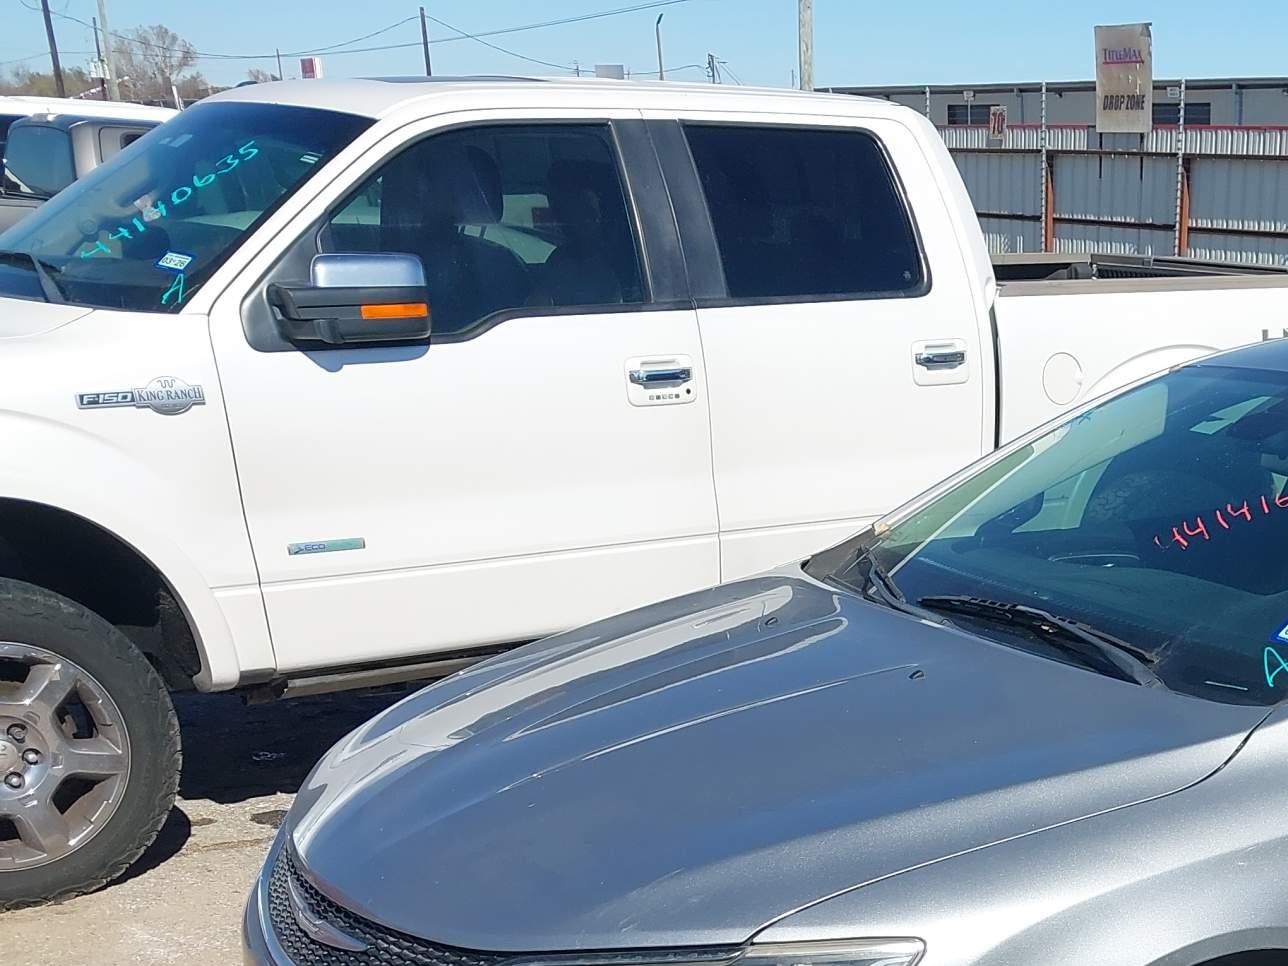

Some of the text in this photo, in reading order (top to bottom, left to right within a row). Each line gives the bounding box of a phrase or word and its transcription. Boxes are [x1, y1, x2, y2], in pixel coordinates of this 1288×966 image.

[1103, 95, 1125, 110] DROP
[137, 388, 165, 402] KING
[166, 386, 203, 401] RANCH
